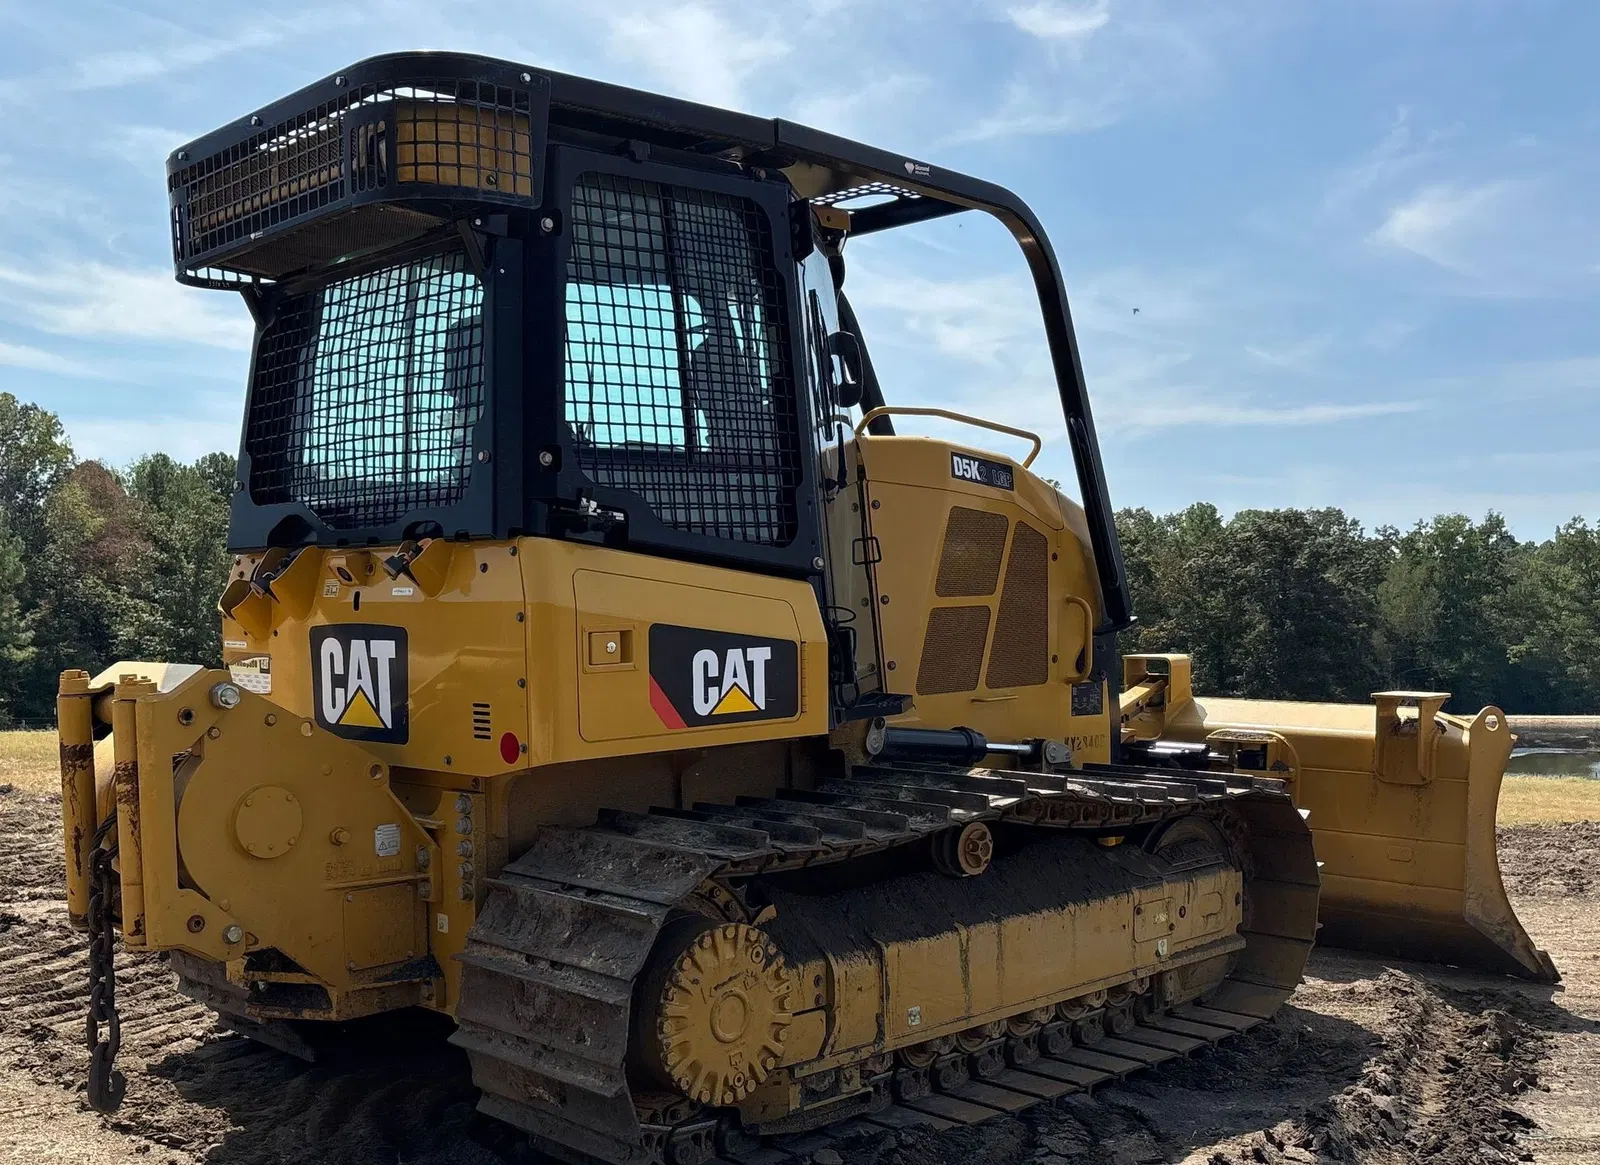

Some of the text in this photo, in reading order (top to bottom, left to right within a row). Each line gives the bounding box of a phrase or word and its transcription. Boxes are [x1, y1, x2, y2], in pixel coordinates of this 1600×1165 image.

[992, 469, 1012, 487] LGP
[320, 637, 396, 729] CAT
[692, 646, 771, 716] CAT
